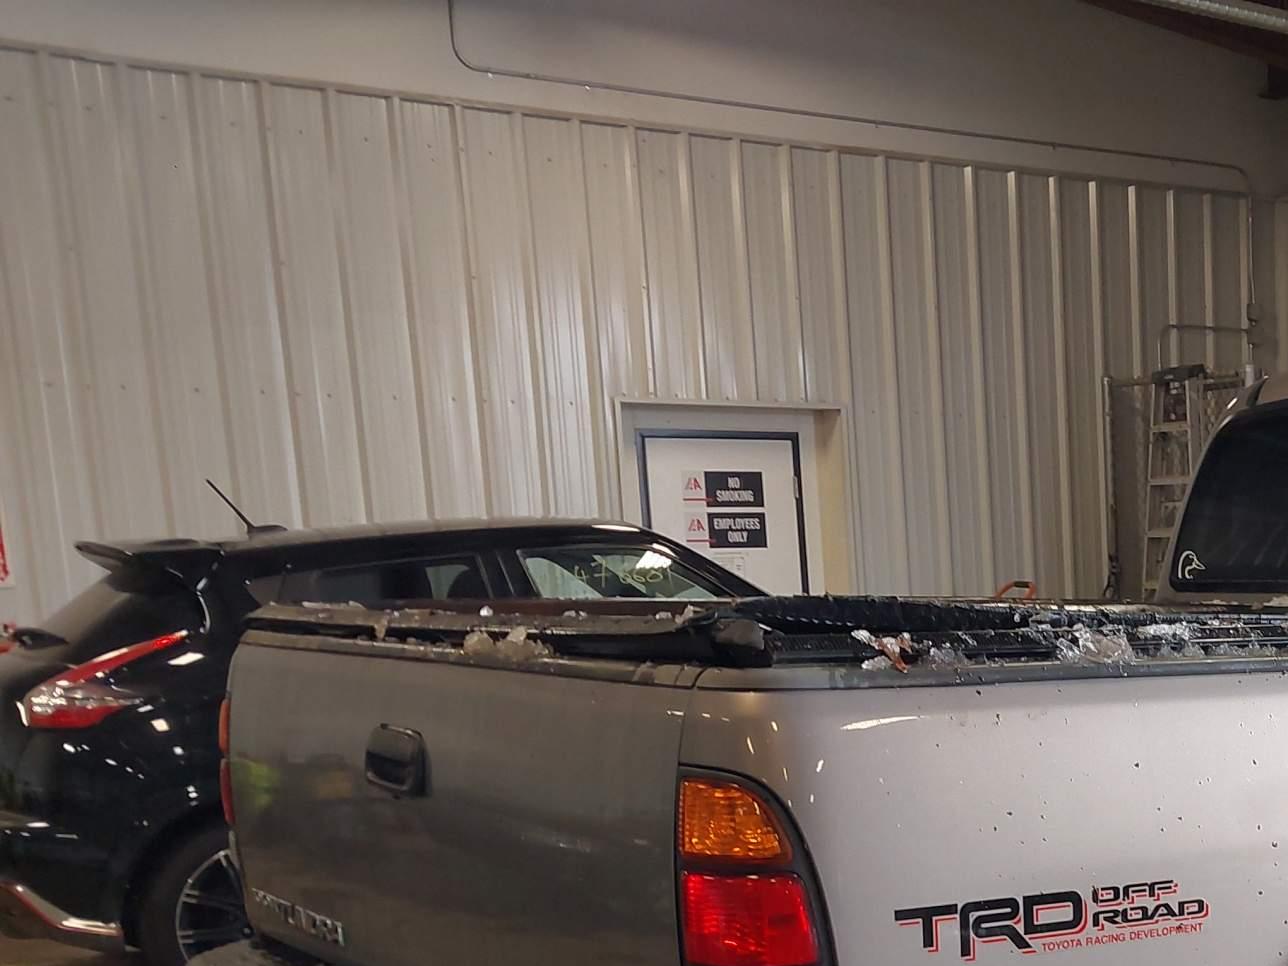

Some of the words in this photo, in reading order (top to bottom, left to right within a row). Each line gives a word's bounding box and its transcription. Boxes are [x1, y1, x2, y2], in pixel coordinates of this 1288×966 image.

[727, 477, 741, 489] NO
[715, 490, 755, 502] SMOKING
[713, 518, 761, 530] EMPLOYEES
[727, 531, 749, 543] ONLY
[1092, 879, 1178, 906] OFF
[1092, 898, 1209, 931] ROAD
[893, 890, 1088, 962] TRD
[1041, 938, 1083, 953] TOYOTA
[1085, 932, 1127, 946] RACING
[1129, 922, 1204, 941] DEVELOPMENT
